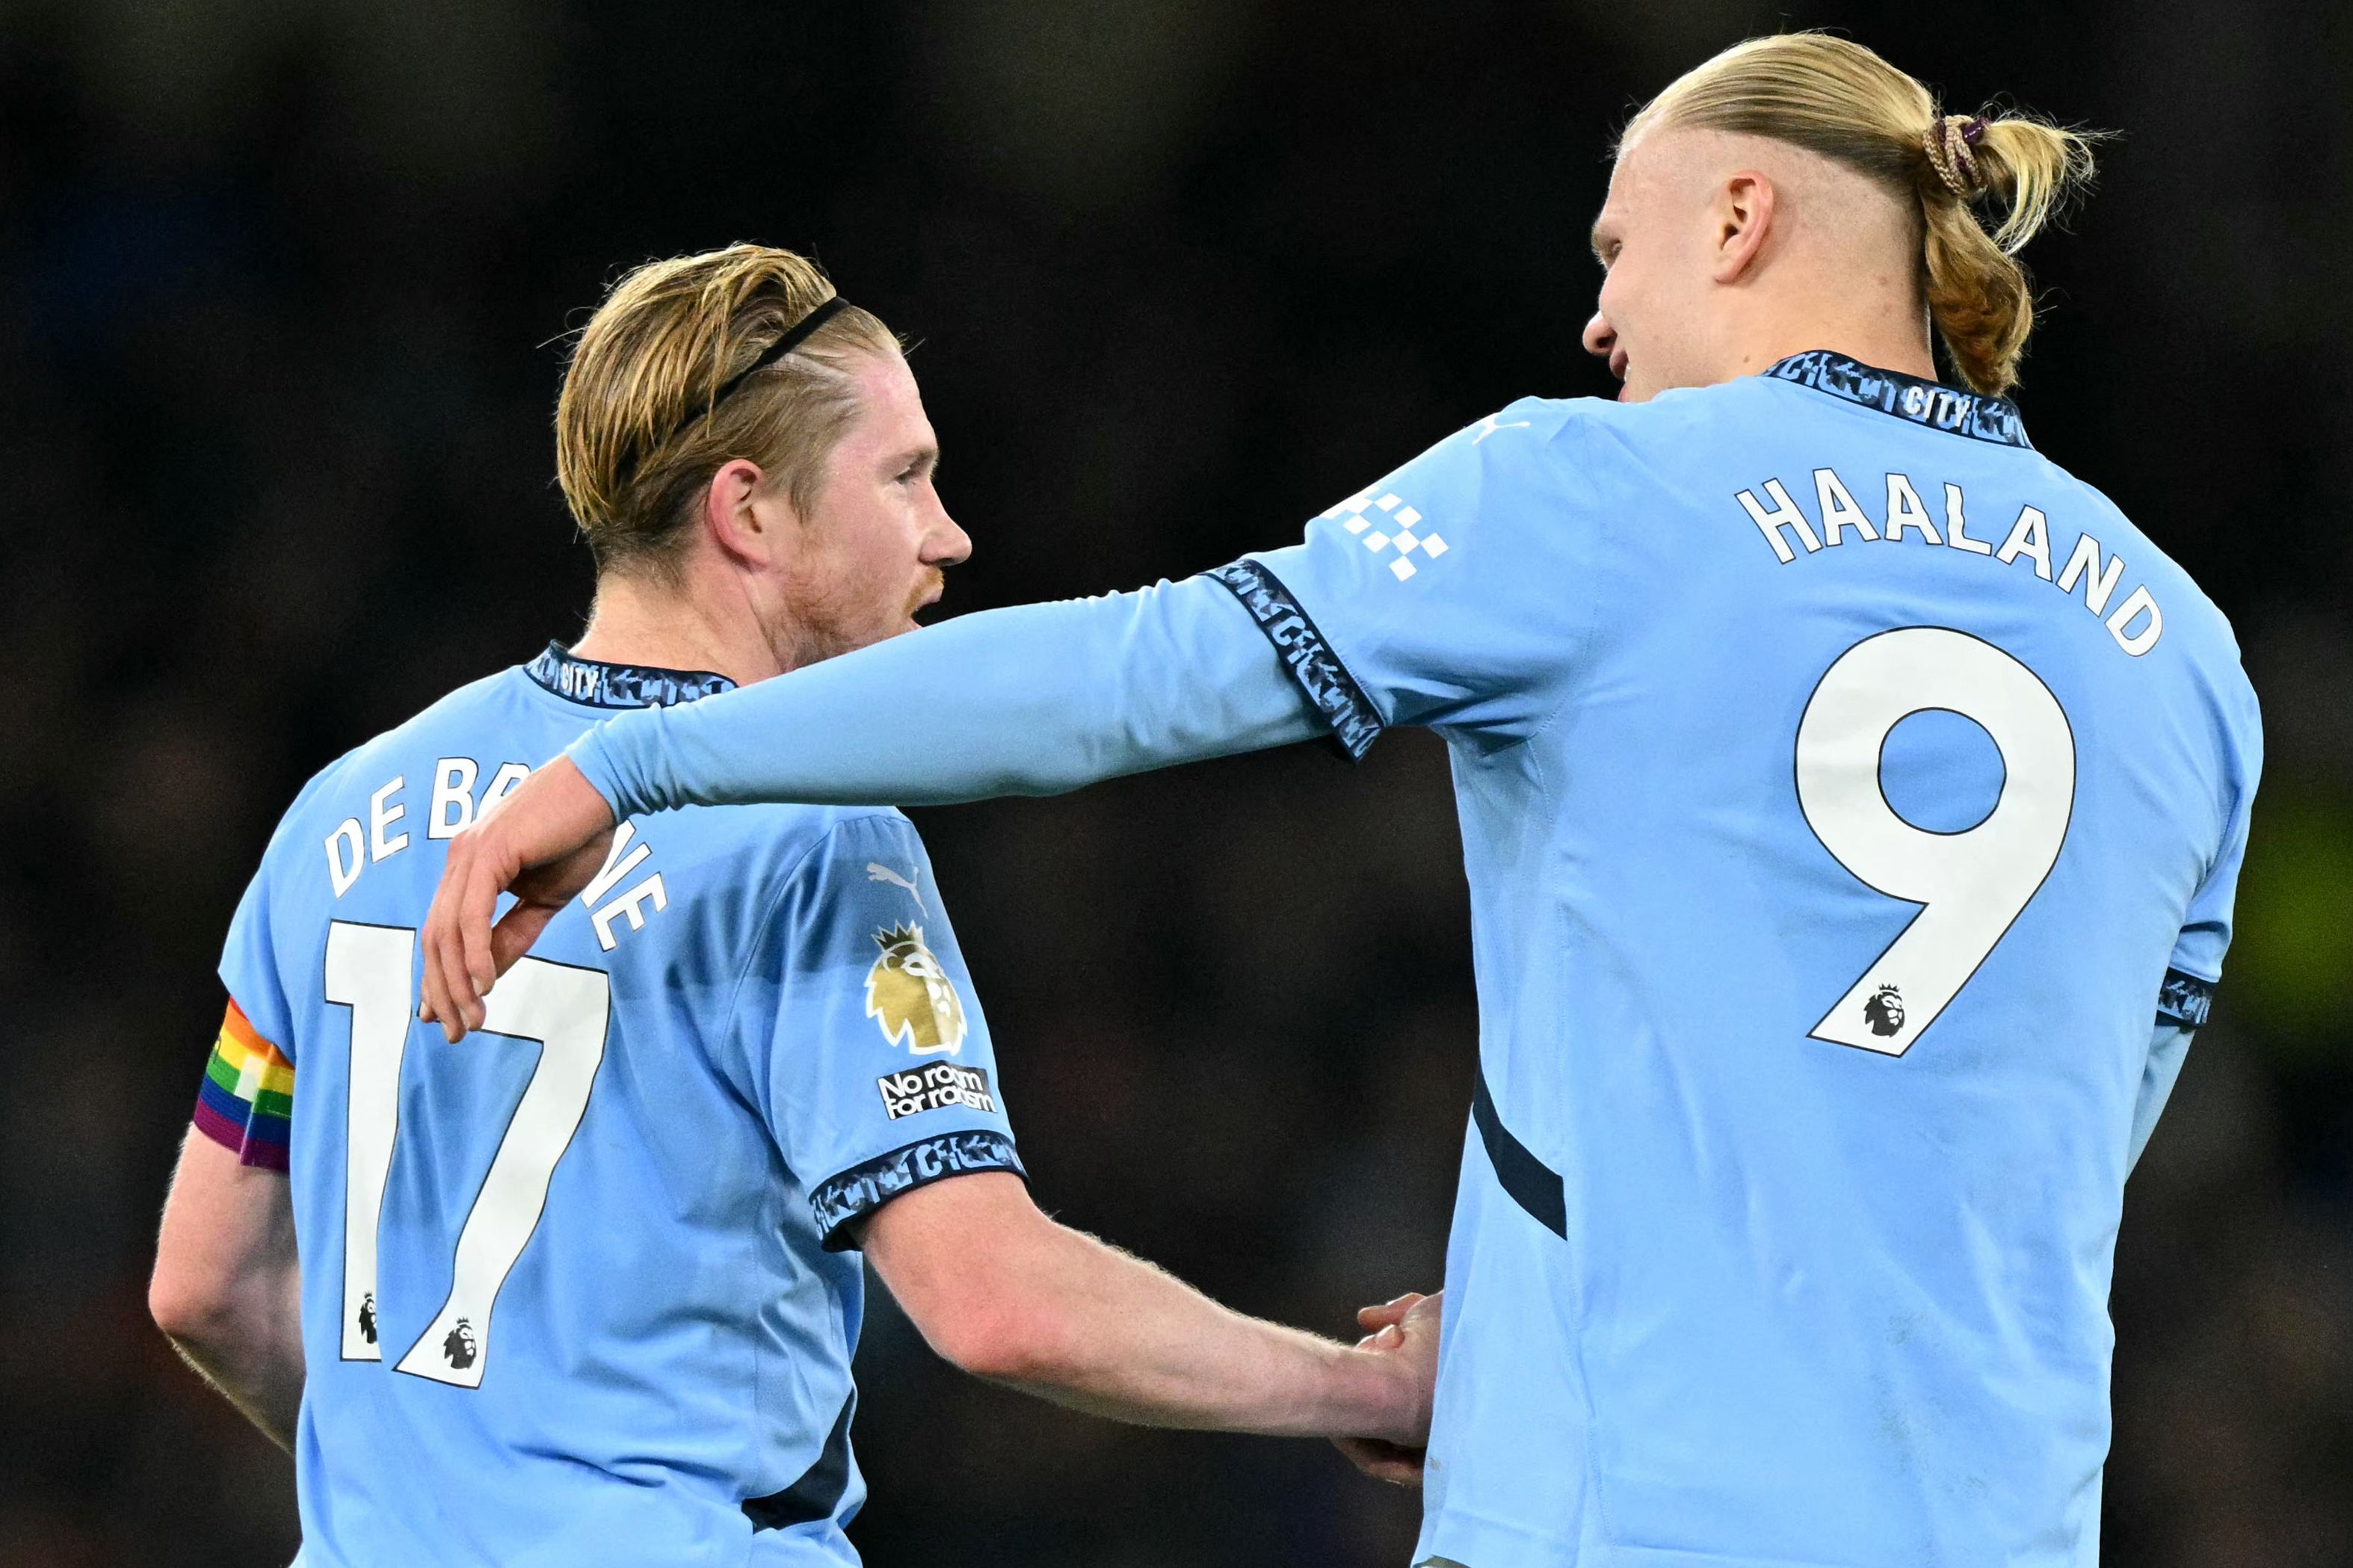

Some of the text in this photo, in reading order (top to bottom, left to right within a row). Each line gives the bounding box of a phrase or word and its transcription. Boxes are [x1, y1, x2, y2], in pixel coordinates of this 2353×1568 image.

[1904, 386, 1972, 428] CITY
[1734, 467, 2164, 658] HAALAND
[559, 662, 599, 698] CITY
[324, 774, 410, 900] DE
[1794, 625, 2076, 1058] 9
[877, 1065, 984, 1102] No room
[885, 1093, 926, 1120] for
[324, 919, 611, 1391] 17
